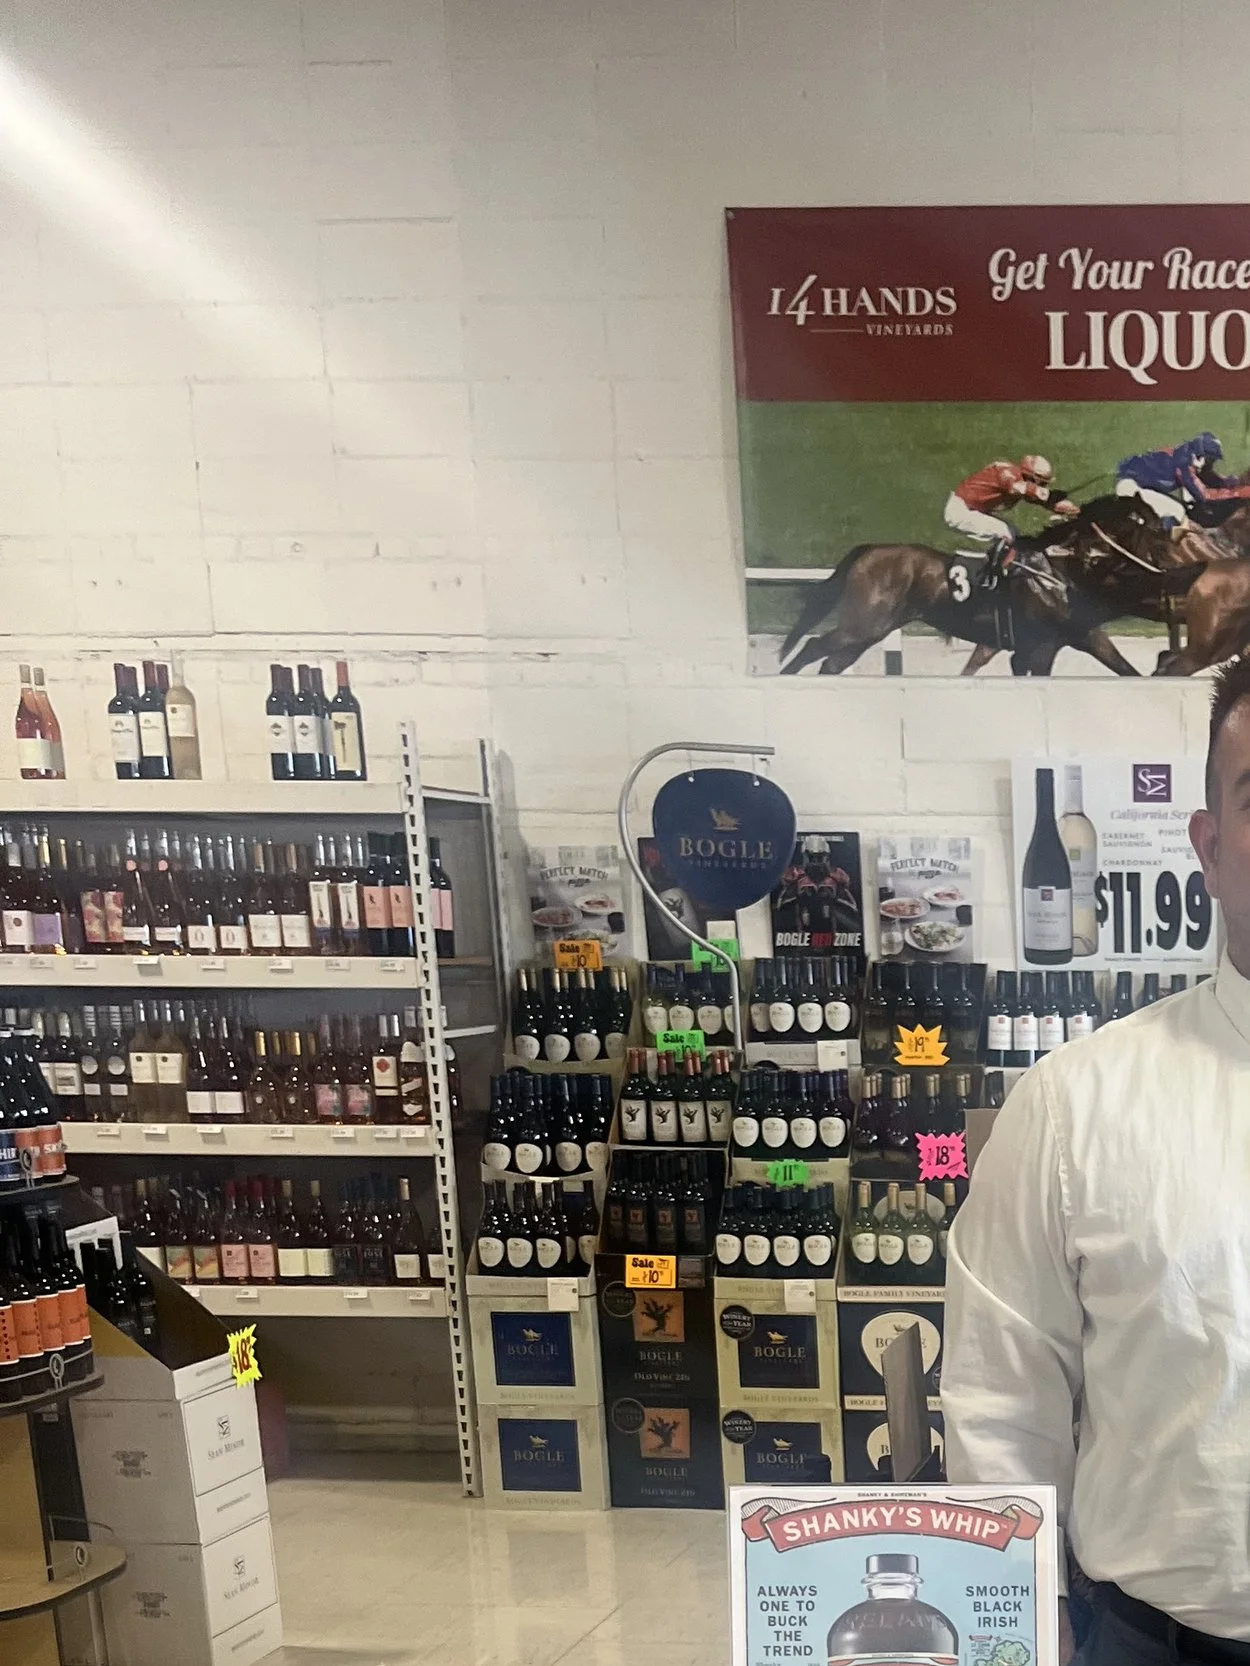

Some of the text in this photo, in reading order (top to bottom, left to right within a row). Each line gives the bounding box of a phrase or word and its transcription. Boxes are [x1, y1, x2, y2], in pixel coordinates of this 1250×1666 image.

[988, 246, 1049, 301] Get
[1057, 246, 1155, 291] Your
[767, 274, 957, 326] 14 HANDS
[866, 323, 953, 336] VINEYARDS
[949, 564, 971, 602] 3
[1109, 808, 1168, 822] California
[1102, 832, 1145, 840] CABERNET
[679, 836, 773, 860] BOGLE
[1102, 840, 1152, 848] SAUVIGNON
[889, 857, 927, 873] PERFECT
[1094, 870, 1212, 954] $11.99
[776, 932, 862, 947] BOGLE RED ZONE
[559, 943, 579, 953] Sale
[662, 1033, 684, 1044] Sale
[631, 1257, 655, 1269] Sale
[843, 1290, 904, 1298] BOGLE FAMILY
[722, 1313, 751, 1321] WINERY
[733, 1320, 752, 1328] YEAR
[640, 1350, 681, 1361] BOGLE
[753, 1346, 807, 1359] BOGLE
[724, 1419, 752, 1427] WINERY
[207, 1438, 245, 1461] SEAN MINOR
[514, 1450, 565, 1462] BOGLE
[783, 1506, 1001, 1542] SHANKY'S WHIP
[757, 1585, 818, 1597] ALWAYS
[965, 1585, 1030, 1597] SMOOTH
[760, 1600, 815, 1612] ONE TO
[973, 1601, 1022, 1612] BLACK
[768, 1615, 808, 1627] BUCK
[978, 1616, 1018, 1628] IRISH
[773, 1630, 802, 1642] THE
[763, 1645, 813, 1657] TREND
